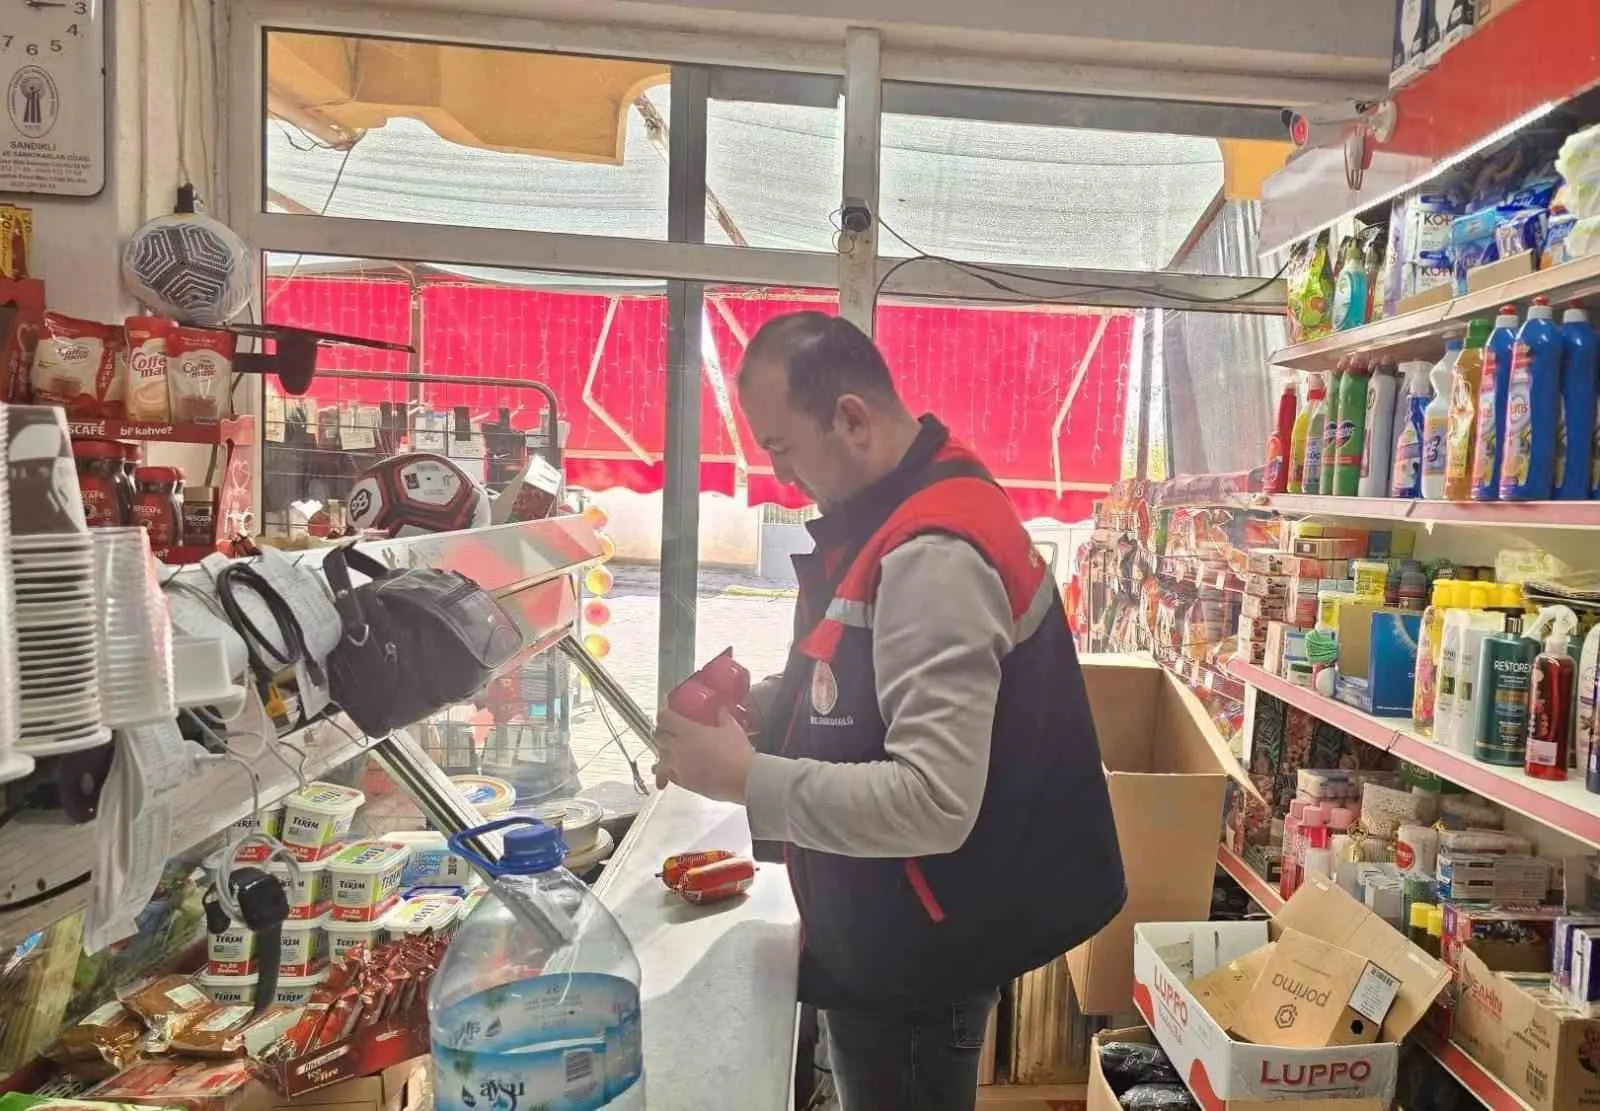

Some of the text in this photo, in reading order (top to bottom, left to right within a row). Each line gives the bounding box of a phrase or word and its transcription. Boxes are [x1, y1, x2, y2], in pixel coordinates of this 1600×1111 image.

[74, 2, 87, 15] 3
[66, 24, 78, 36] 4
[2, 35, 13, 48] 7
[50, 40, 62, 52] 5
[26, 44, 38, 55] 6
[132, 351, 167, 371] Coffe
[67, 420, 105, 436] SCAFÉ
[1494, 660, 1531, 673] RESTORE
[280, 937, 300, 946] EREM
[1271, 973, 1333, 1008] porima
[1260, 1059, 1372, 1085] LUPPO
